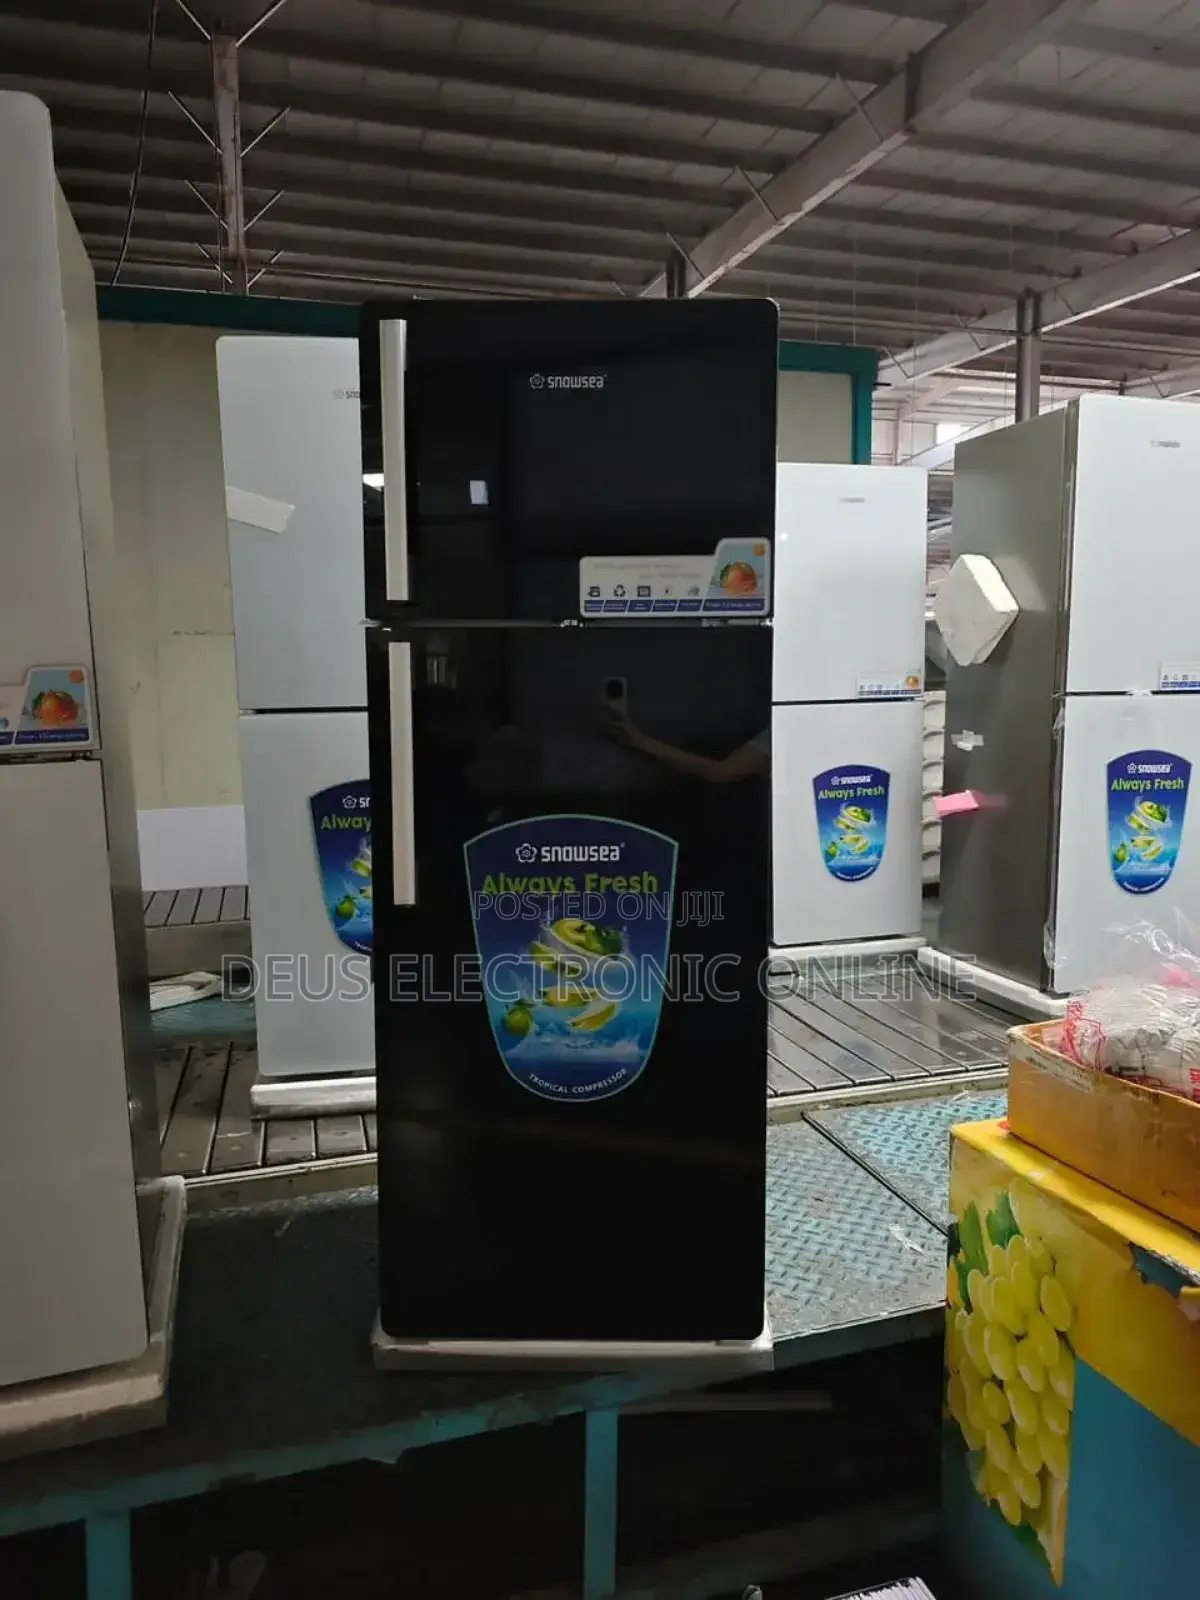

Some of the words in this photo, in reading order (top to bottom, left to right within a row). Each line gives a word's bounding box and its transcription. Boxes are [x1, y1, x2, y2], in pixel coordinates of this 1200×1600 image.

[547, 374, 605, 389] snowsea
[819, 788, 855, 800] Always
[856, 785, 885, 797] Fresh
[1111, 777, 1152, 793] Always
[1154, 776, 1184, 790] Fresh
[320, 814, 371, 833] Alway
[541, 843, 621, 862] snowsea
[481, 872, 576, 897] Always
[584, 870, 659, 894] Fresh
[528, 1072, 568, 1095] TROPICAL
[571, 1067, 628, 1094] COMPRESSOR
